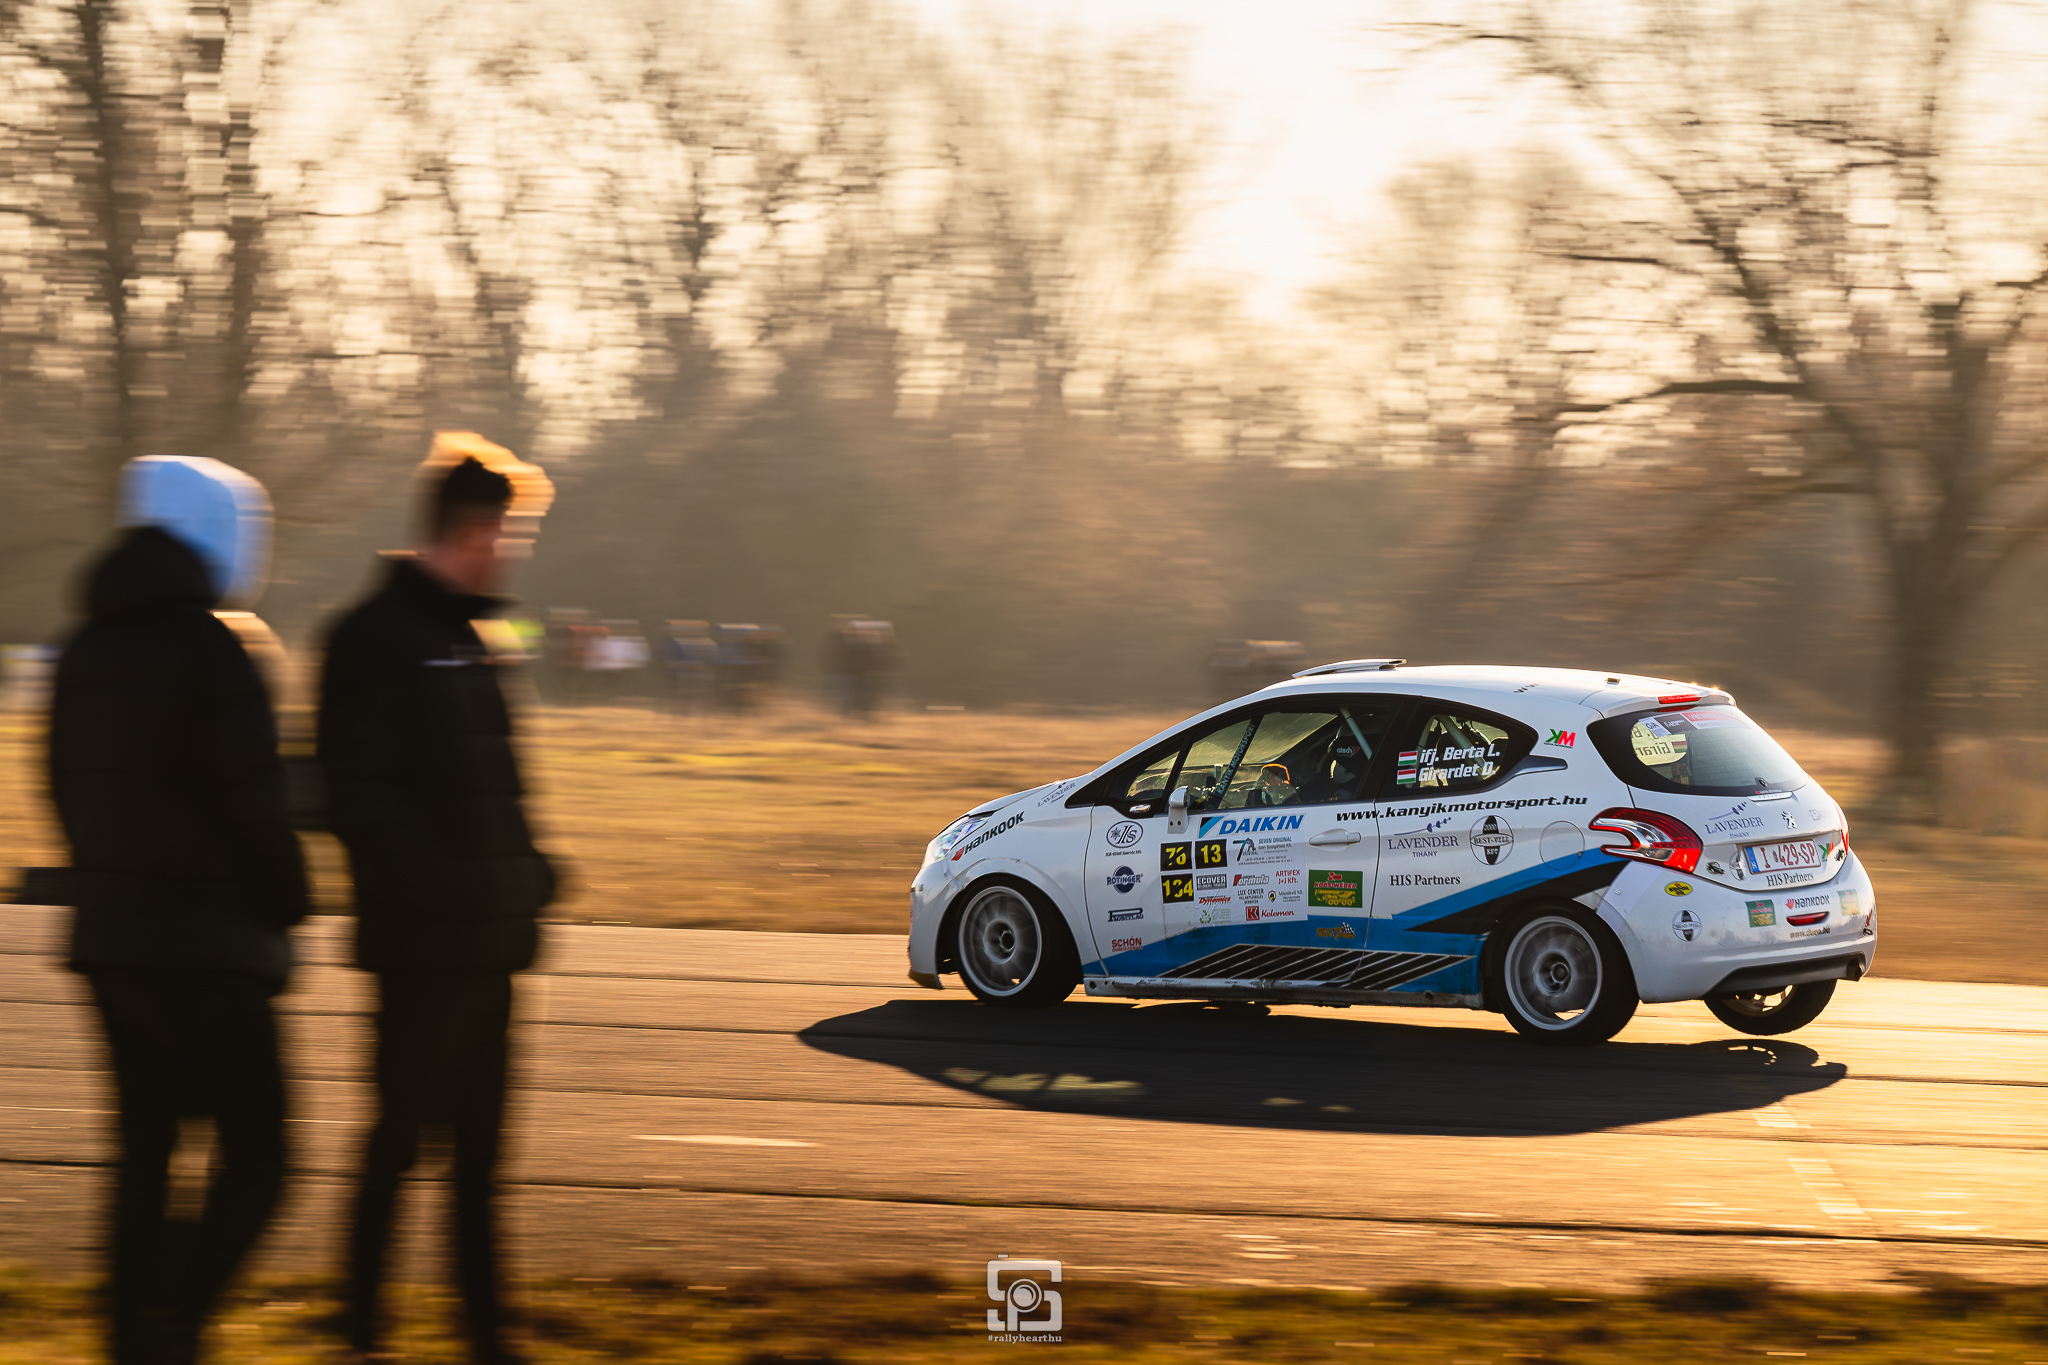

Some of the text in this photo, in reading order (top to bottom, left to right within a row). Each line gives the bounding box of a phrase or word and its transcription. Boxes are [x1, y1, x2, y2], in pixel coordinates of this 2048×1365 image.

[1419, 743, 1500, 766] ifj. Berta L.
[1217, 768, 1234, 794] KANYIK
[1418, 761, 1496, 782] Girardet D.
[1336, 795, 1588, 822] www.kanyikmotorsport.hu
[1218, 814, 1304, 836] DAIKIN
[1704, 816, 1764, 835] LAVENDER
[1387, 836, 1459, 850] LAVENDER
[1200, 844, 1222, 864] 13
[1412, 850, 1438, 858] TIHANY
[1275, 869, 1300, 877] ARTIFEX
[1389, 874, 1461, 887] HIS Partners
[1766, 872, 1814, 888] HIS Partners
